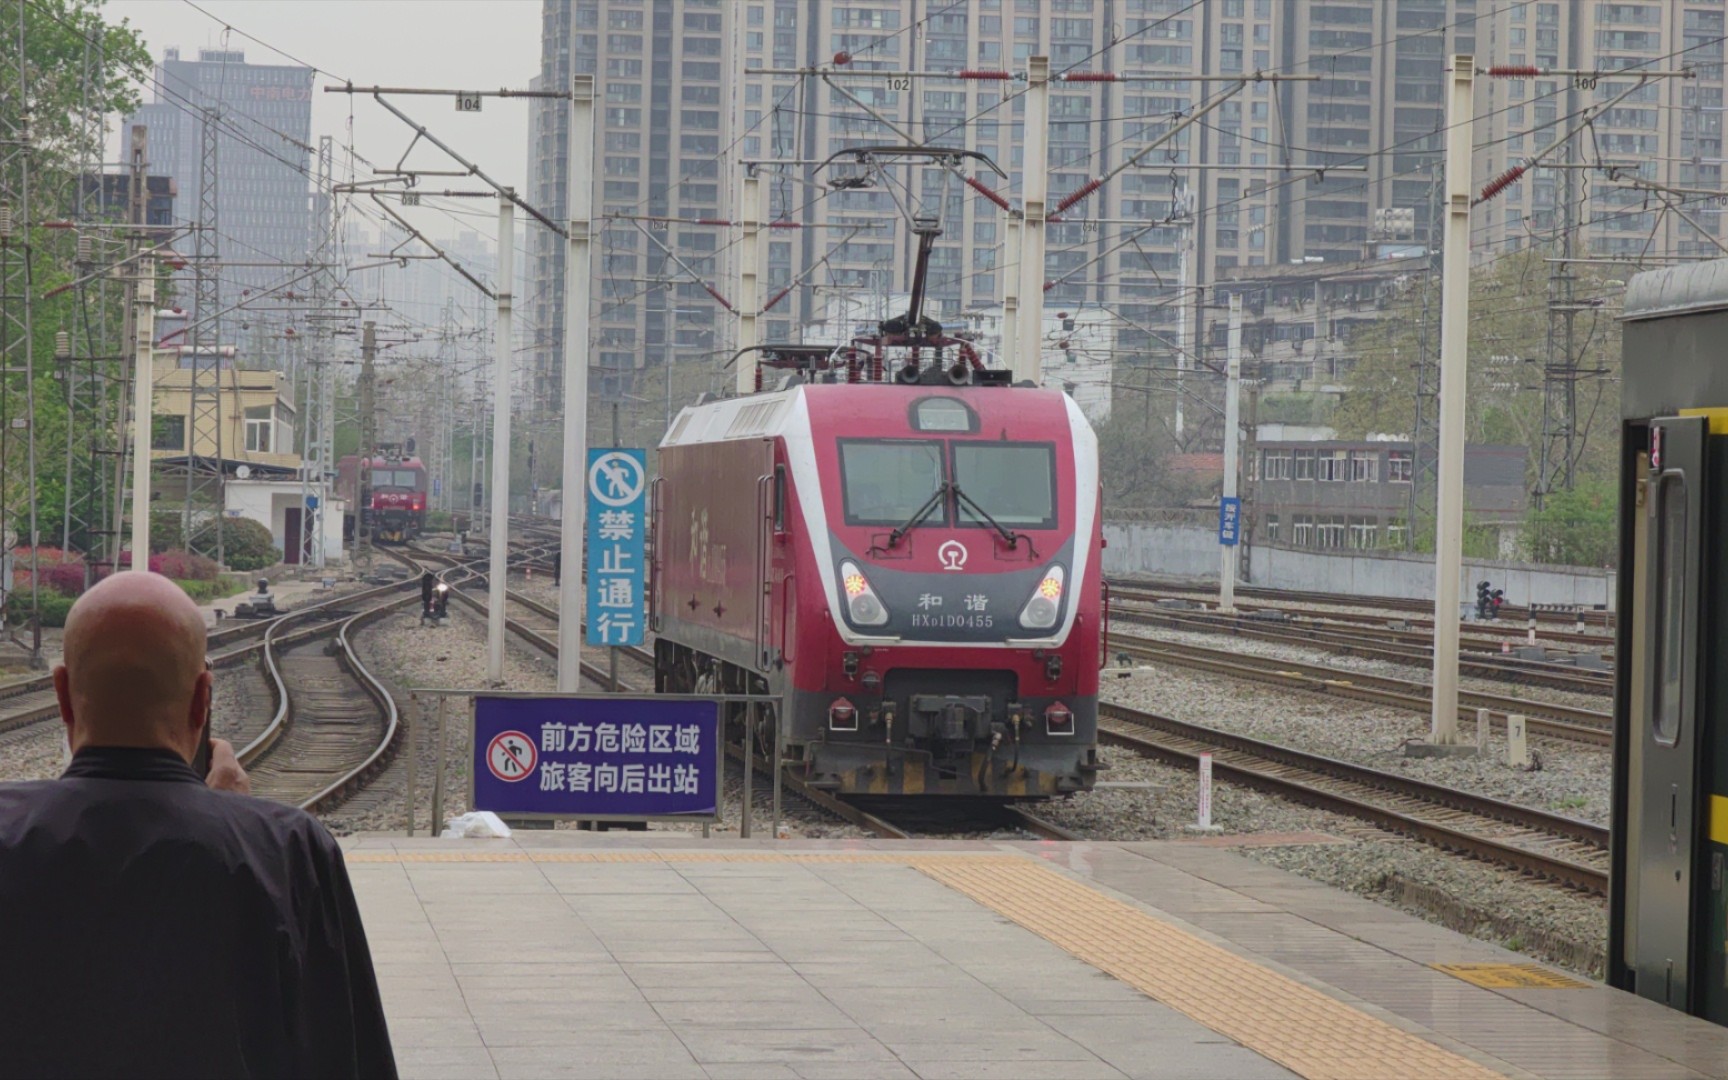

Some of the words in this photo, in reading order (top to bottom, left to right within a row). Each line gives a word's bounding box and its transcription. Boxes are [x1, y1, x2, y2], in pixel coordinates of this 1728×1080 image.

[887, 79, 910, 91] 102
[1575, 78, 1597, 90] 100
[457, 98, 480, 110] 104
[597, 510, 635, 643] 禁止通行
[918, 593, 989, 611] 和谐
[912, 614, 993, 628] HXD1D0455
[541, 721, 701, 754] 前方危险区域
[1515, 725, 1521, 738] 7
[539, 761, 700, 794] 旅客向后出站
